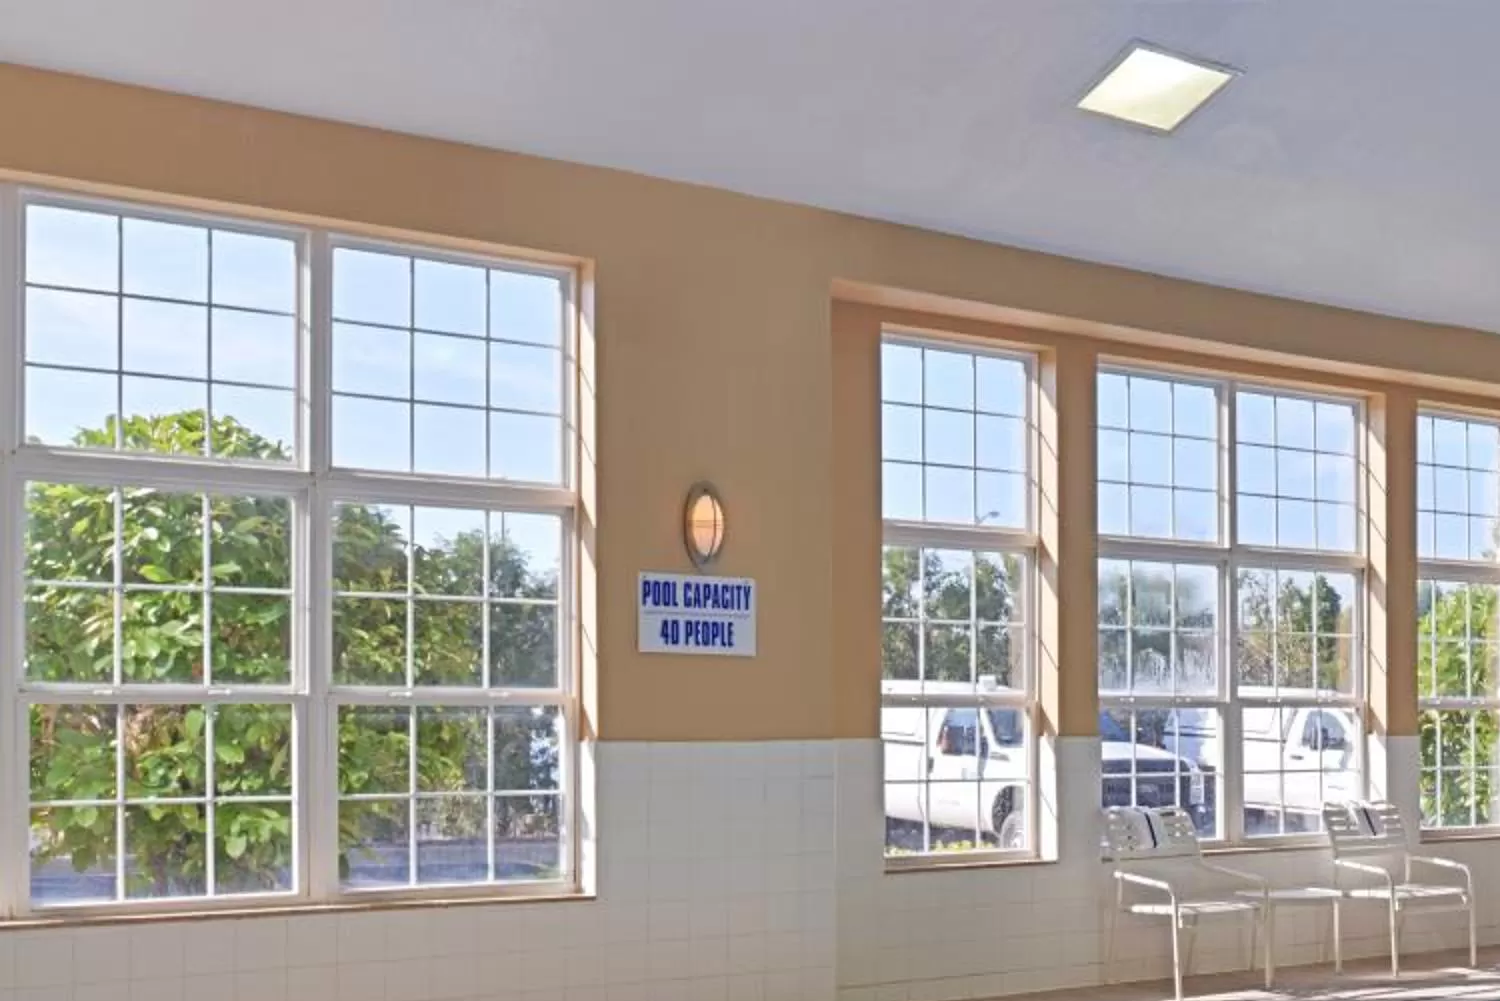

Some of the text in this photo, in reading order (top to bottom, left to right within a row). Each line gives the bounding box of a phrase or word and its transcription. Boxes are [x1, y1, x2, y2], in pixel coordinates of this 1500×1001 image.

[642, 580, 752, 610] POOL CAPACITY
[660, 620, 734, 647] 40 PEOPLE
